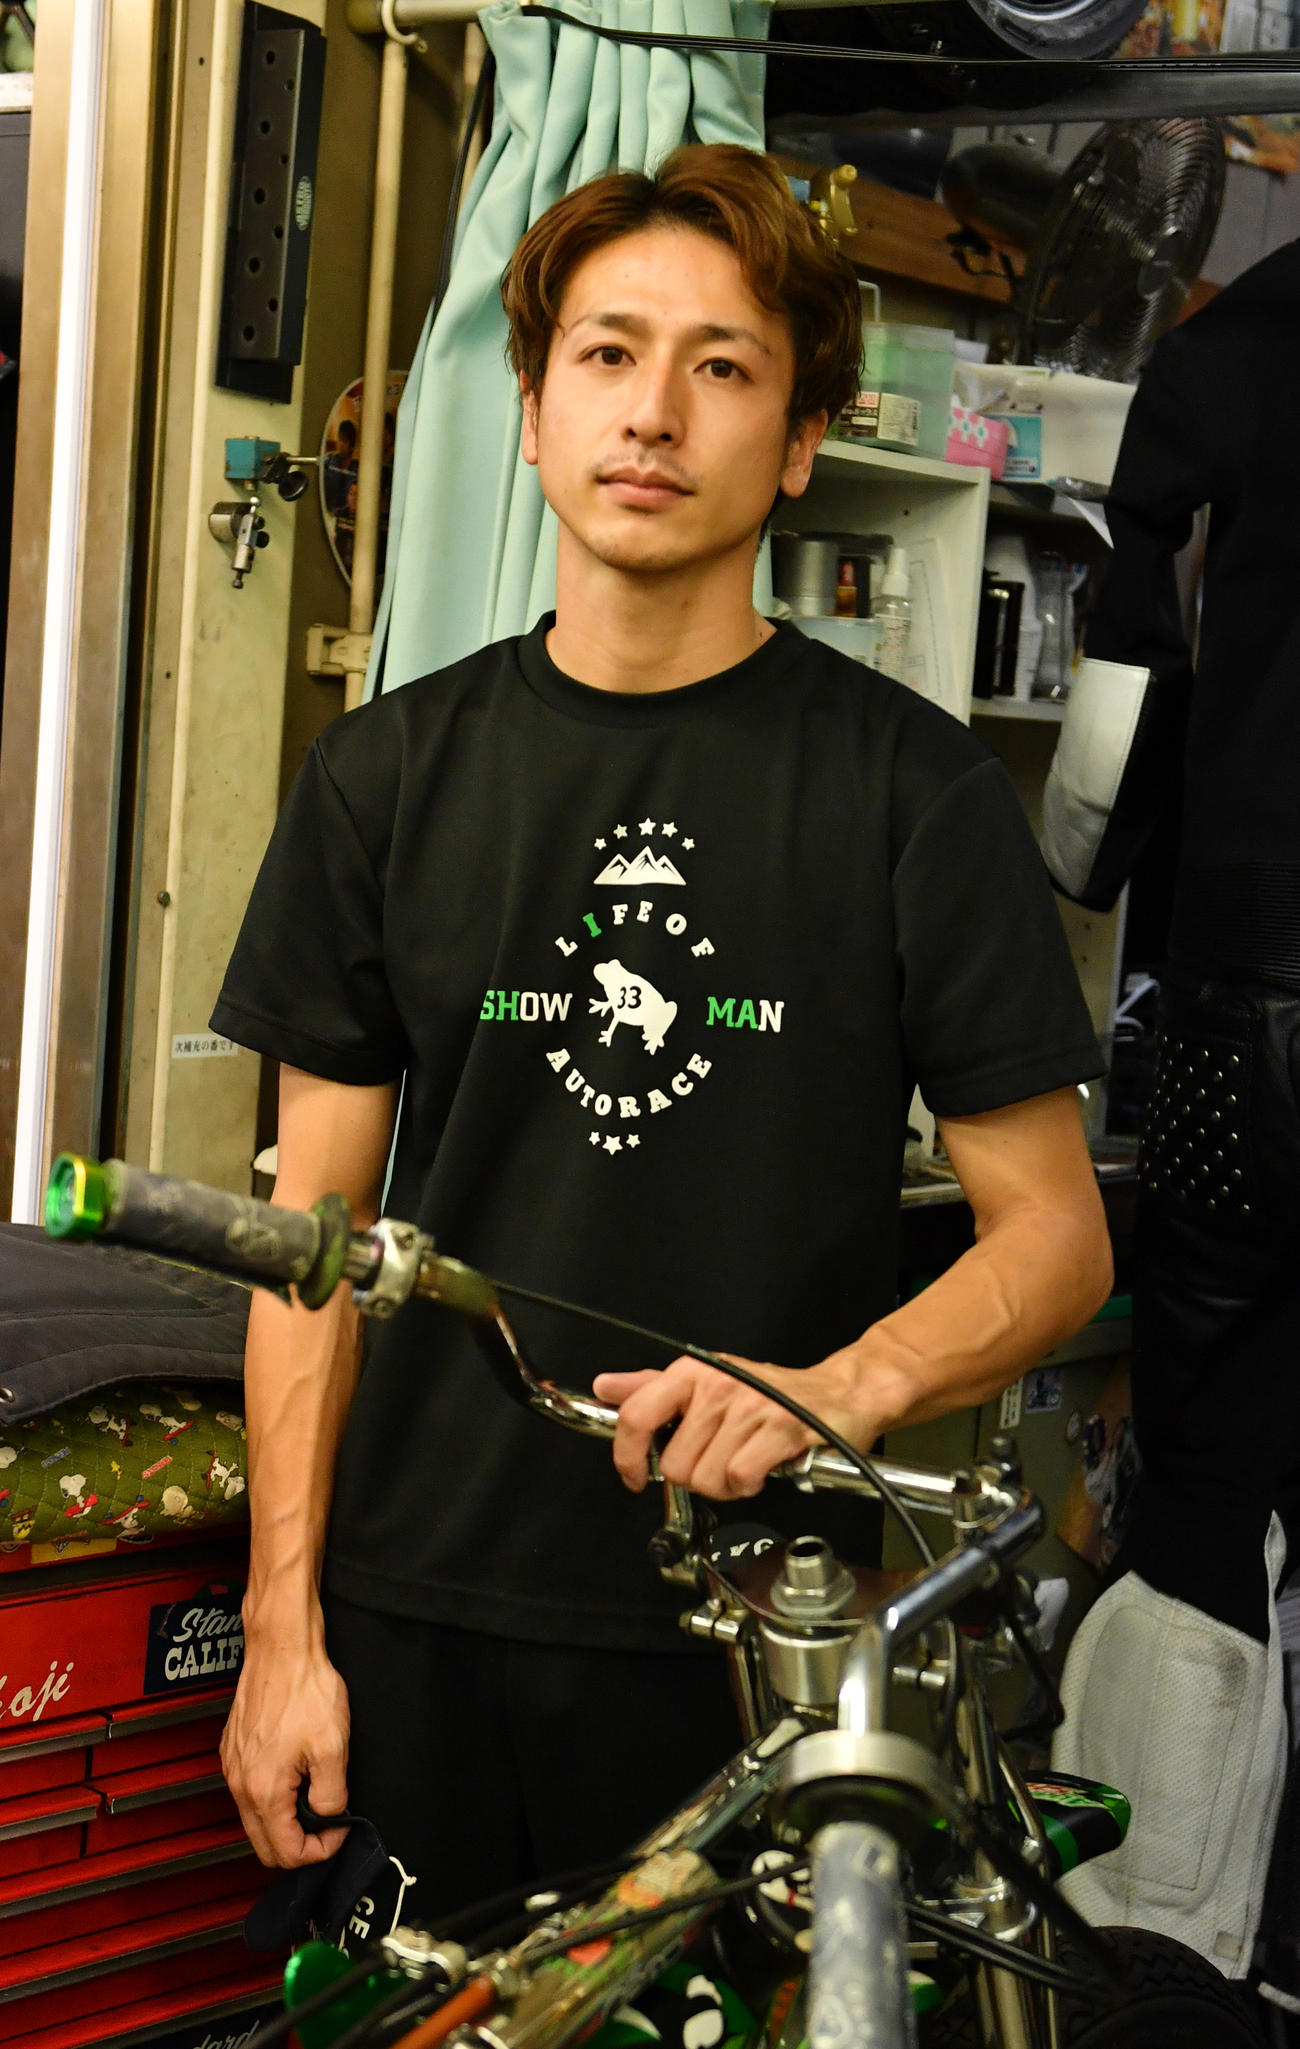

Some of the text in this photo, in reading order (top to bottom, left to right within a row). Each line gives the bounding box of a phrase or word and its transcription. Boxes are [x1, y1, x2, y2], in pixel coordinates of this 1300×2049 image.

[555, 901, 715, 957] LIFE OF
[480, 990, 785, 1033] SHOW MAN
[617, 986, 642, 1009] 33
